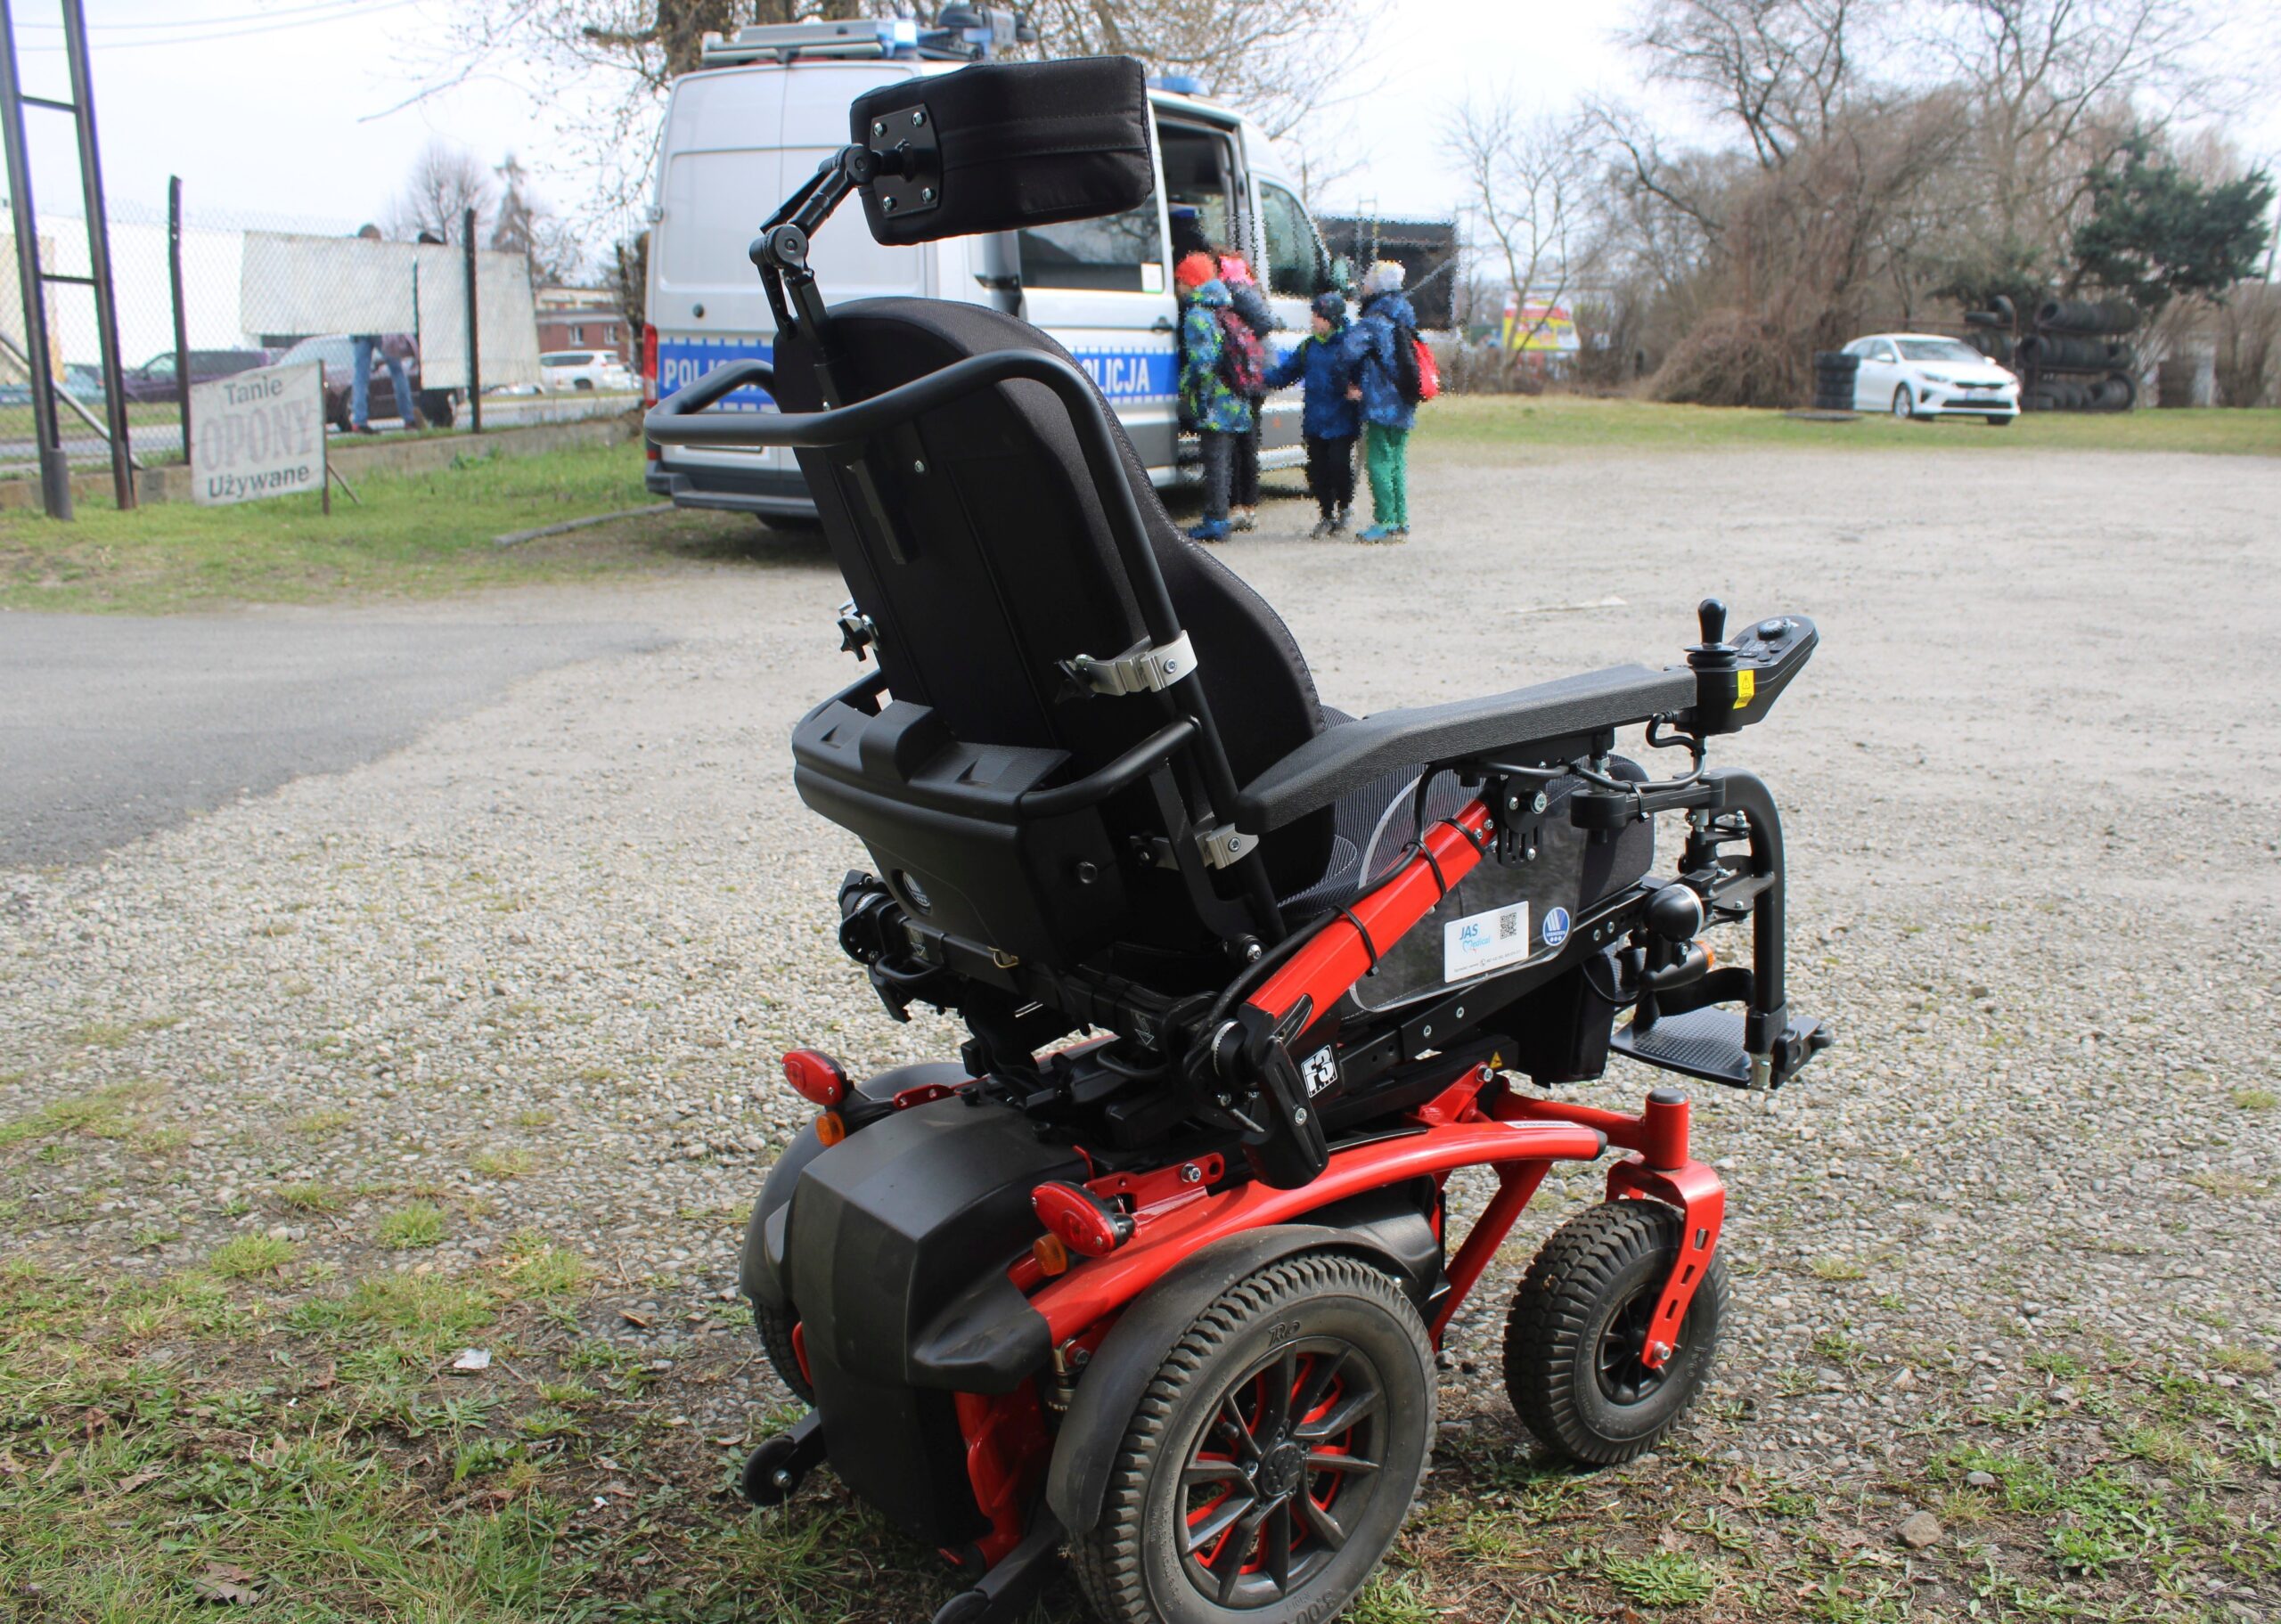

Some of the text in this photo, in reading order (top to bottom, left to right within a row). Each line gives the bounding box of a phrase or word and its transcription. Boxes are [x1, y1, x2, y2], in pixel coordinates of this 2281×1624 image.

[224, 376, 283, 405] Tanie
[1081, 358, 1150, 394] OLICJA
[200, 399, 315, 471] OPONY
[208, 464, 310, 499] Używane
[1459, 923, 1479, 941] JAS
[1304, 1049, 1335, 1092] F3
